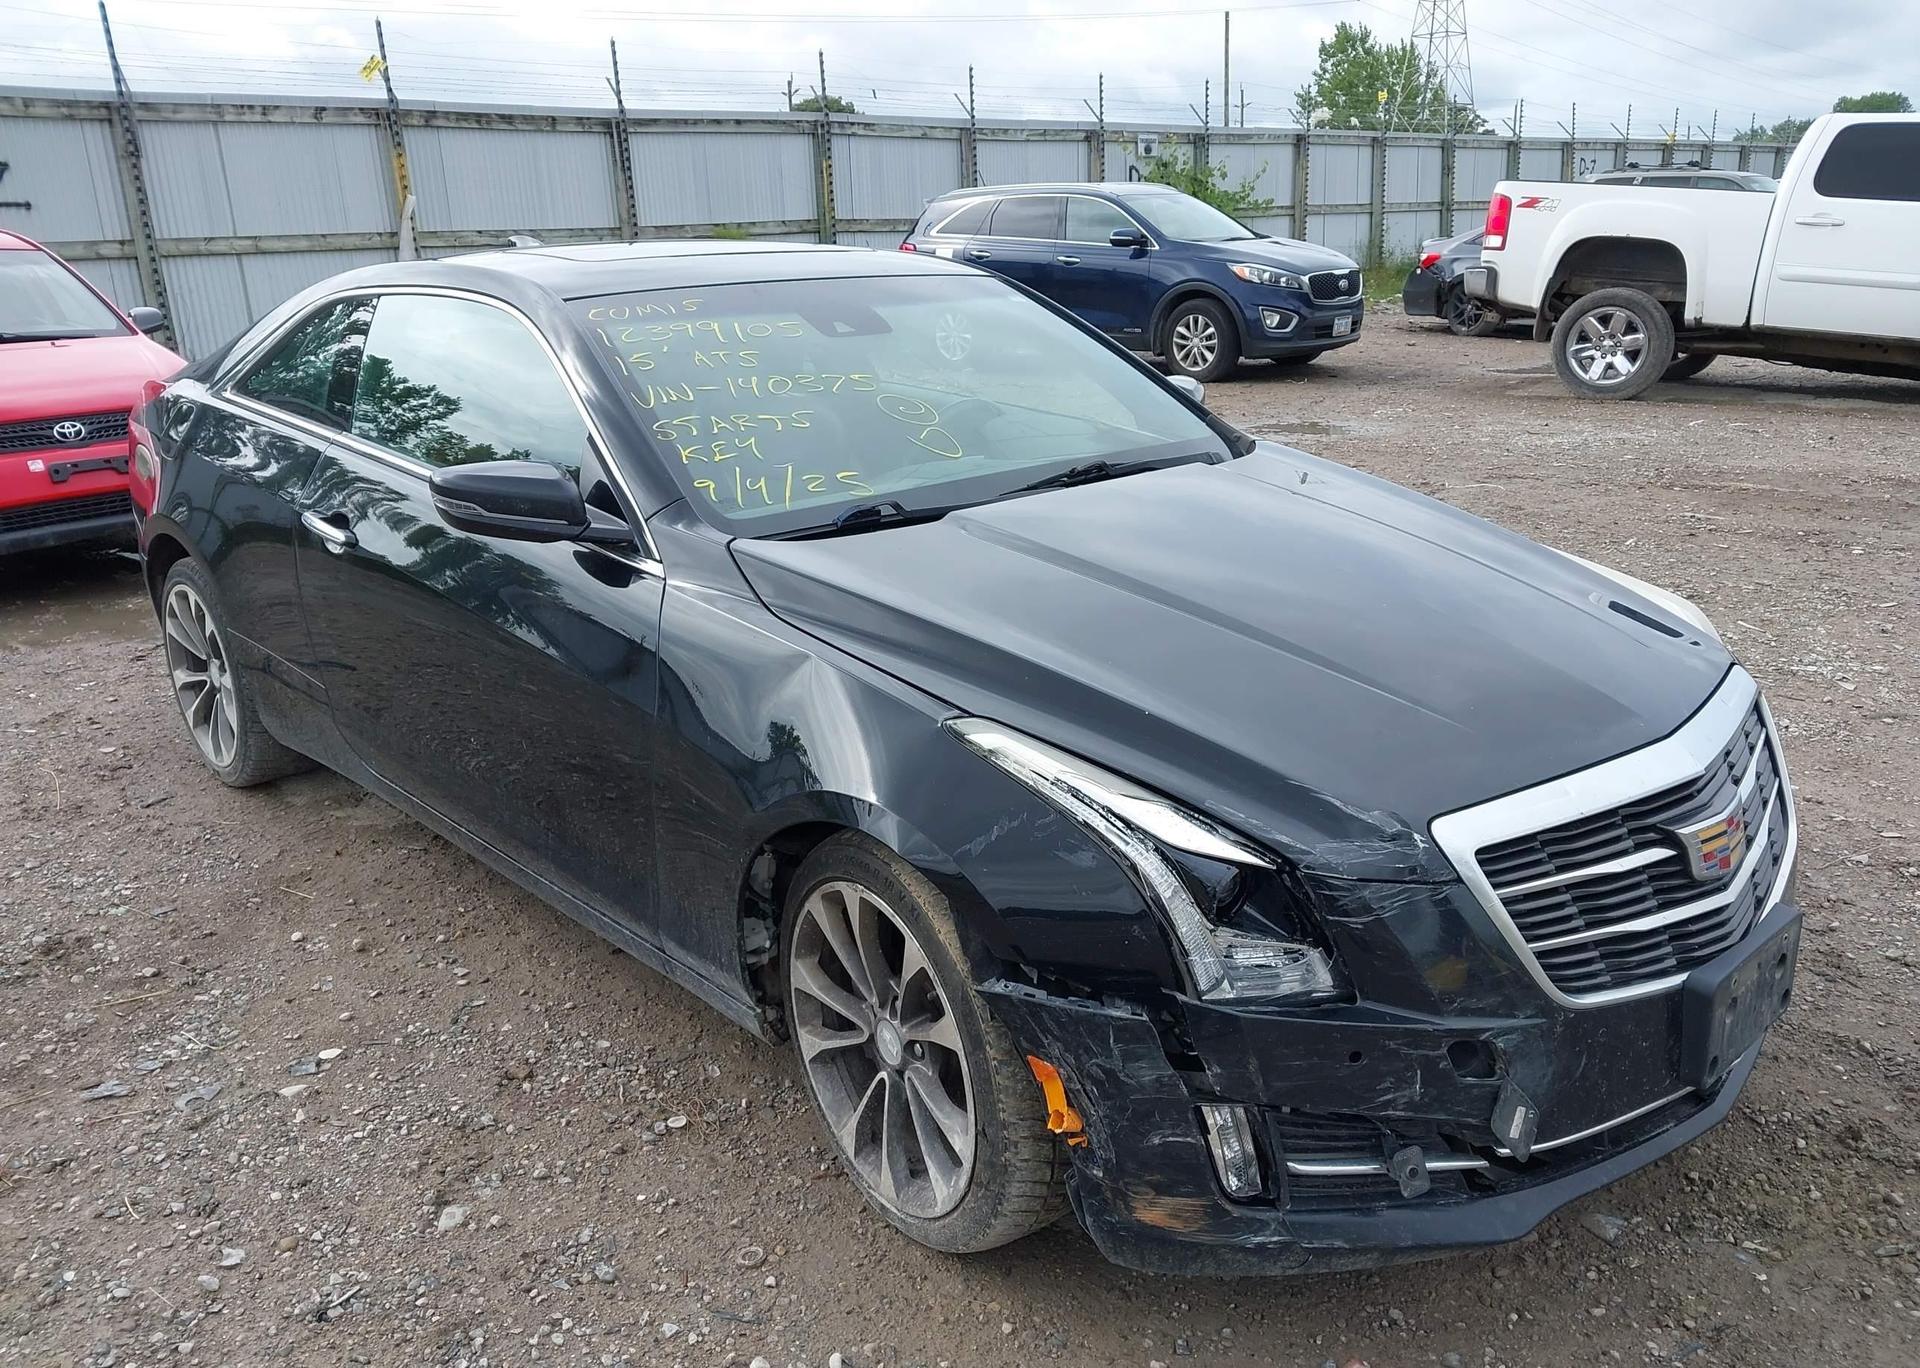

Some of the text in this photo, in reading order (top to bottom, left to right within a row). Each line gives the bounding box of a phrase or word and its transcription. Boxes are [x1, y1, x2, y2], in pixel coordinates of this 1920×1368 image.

[596, 320, 804, 349] 12399105
[695, 351, 760, 368] ATS
[653, 410, 815, 441] STARTS
[676, 436, 764, 464] KEY
[693, 462, 874, 511] 9/4/25
